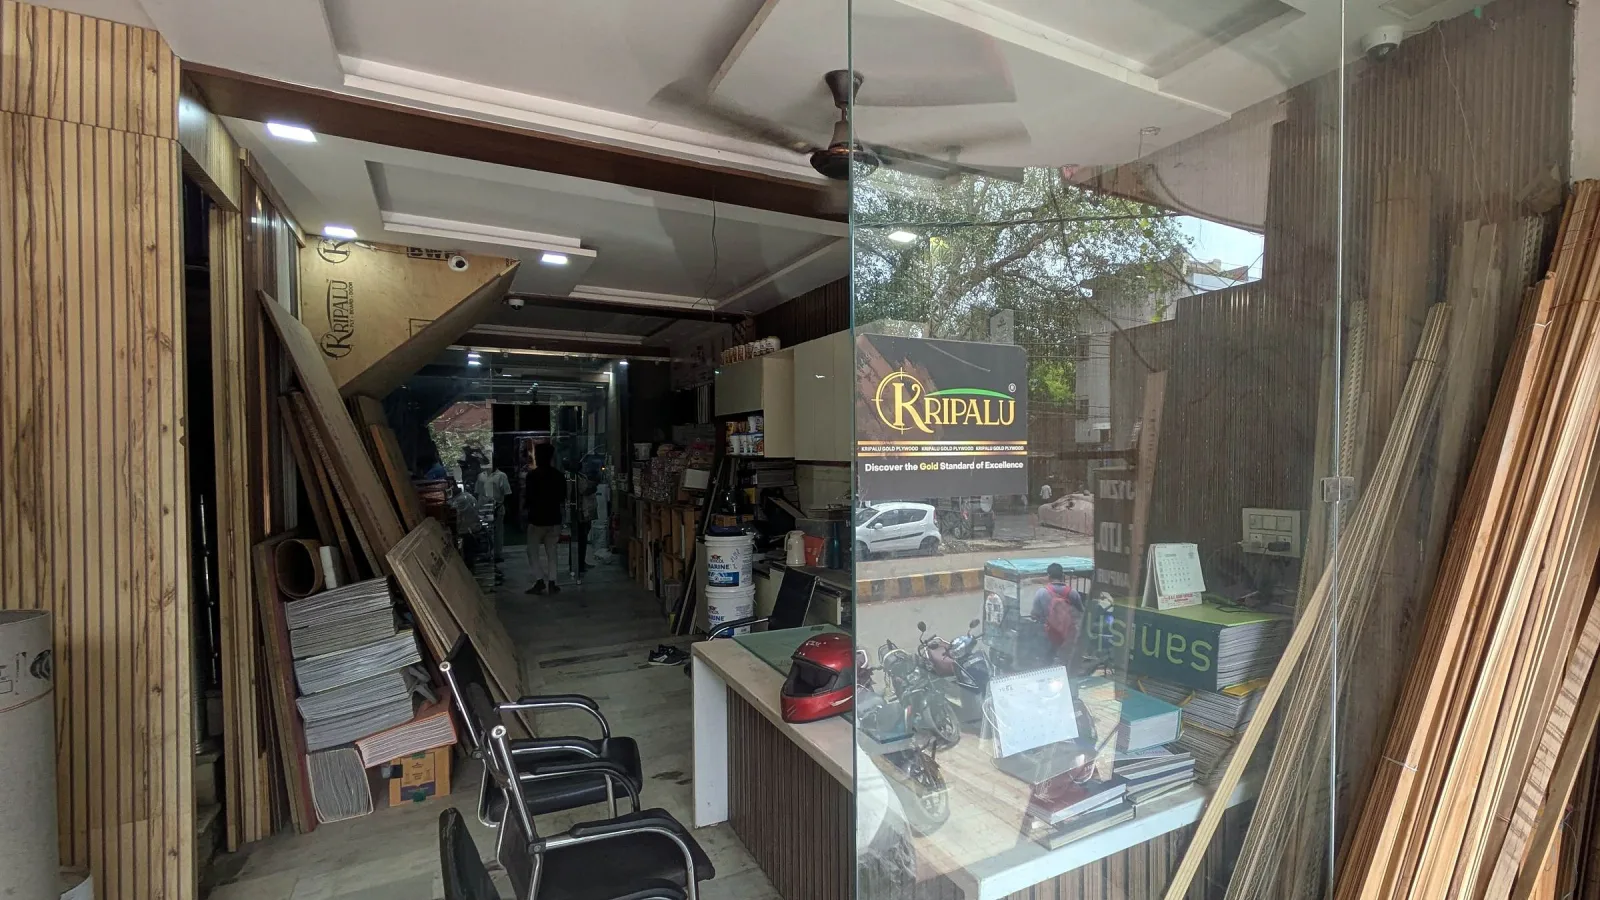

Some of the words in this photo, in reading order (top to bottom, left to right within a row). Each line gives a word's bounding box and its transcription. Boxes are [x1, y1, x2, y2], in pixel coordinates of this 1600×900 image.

[326, 280, 354, 350] KRIPALU
[892, 382, 1016, 434] KRIPALU
[864, 463, 903, 472] Discover
[904, 462, 918, 471] the
[919, 462, 939, 471] Gold
[940, 461, 975, 470] Standard
[976, 461, 984, 470] of
[985, 461, 1024, 469] Excellence
[1087, 611, 1213, 672] sanish
